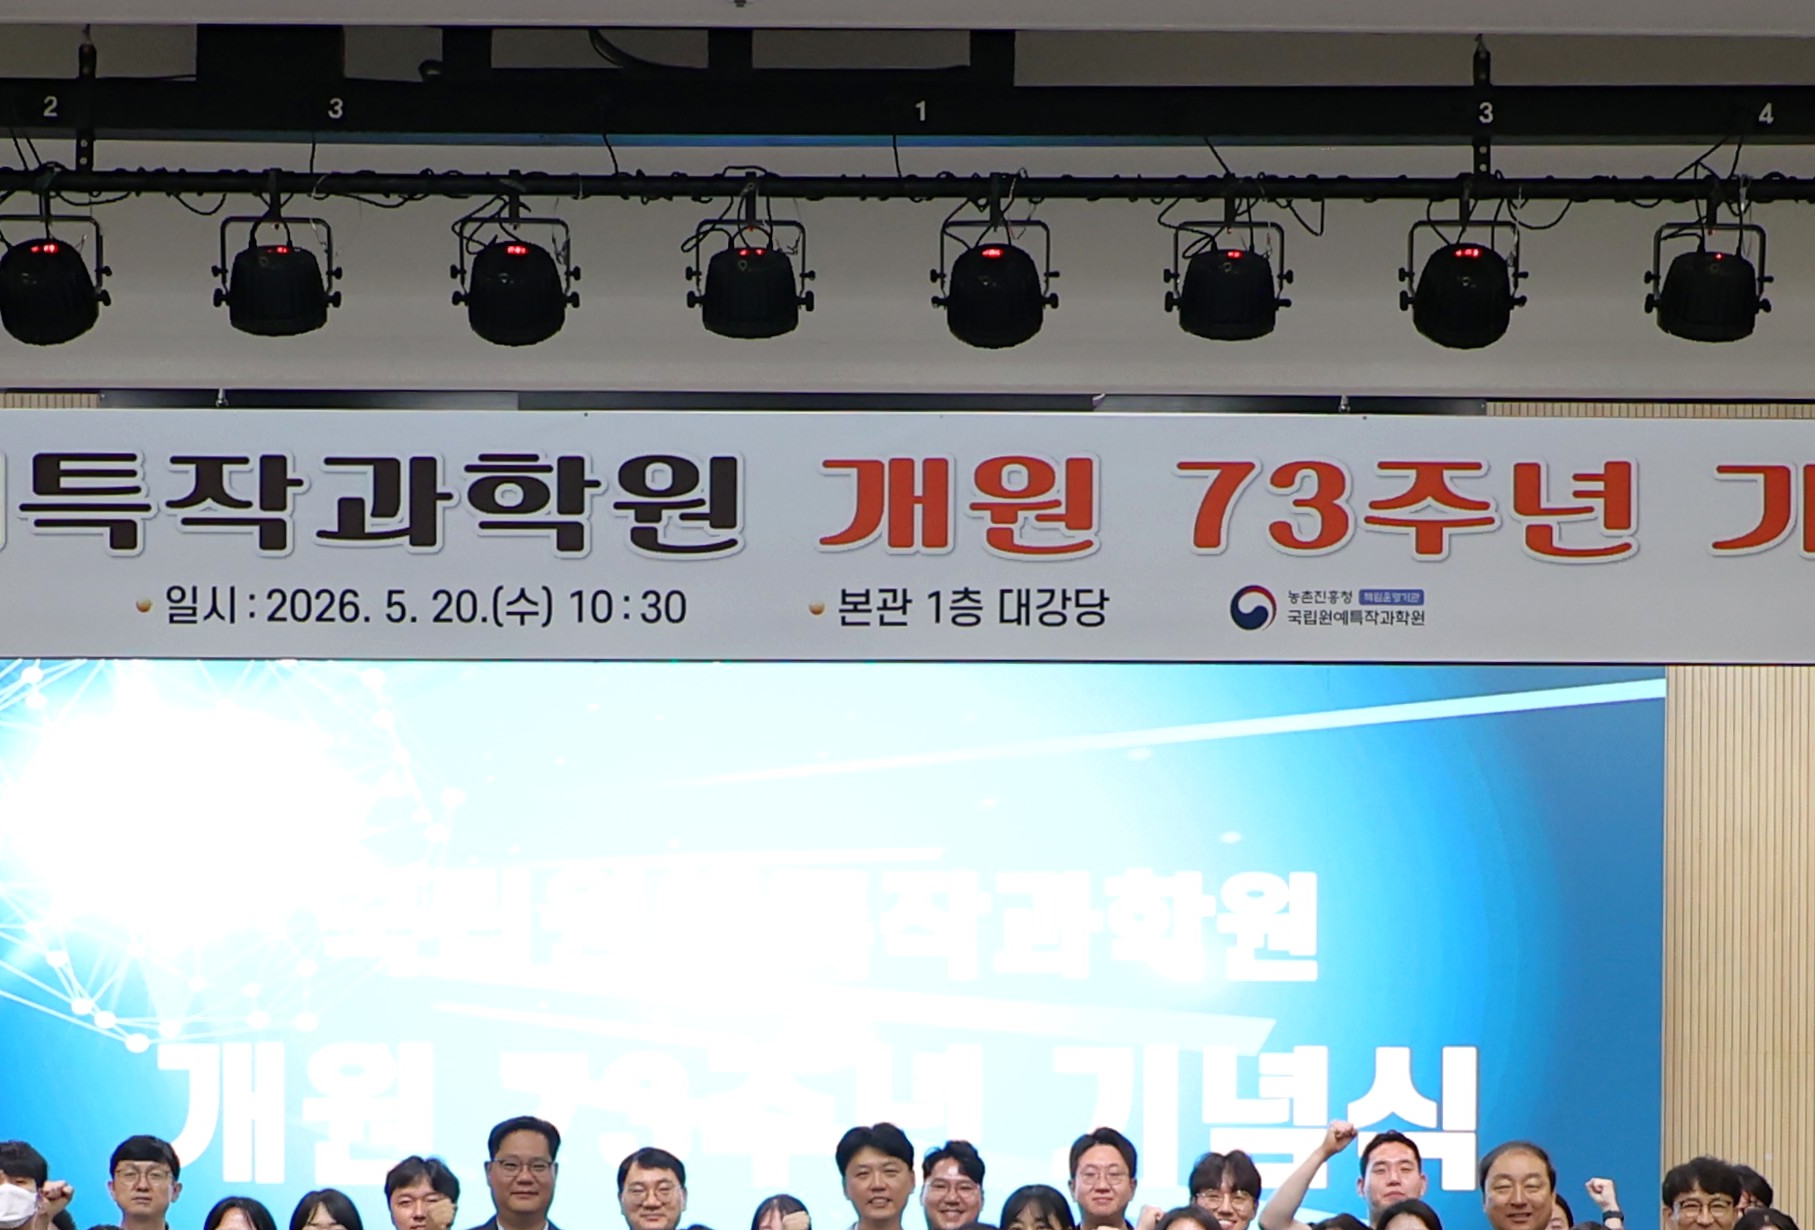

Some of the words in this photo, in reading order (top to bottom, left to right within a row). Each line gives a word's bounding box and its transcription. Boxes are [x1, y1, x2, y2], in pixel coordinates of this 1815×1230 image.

[43, 96, 57, 116] 2
[328, 98, 343, 118] 3
[916, 101, 925, 121] 1
[1479, 102, 1493, 123] 3
[1758, 103, 1774, 123] 4
[822, 456, 1093, 555] 개원
[1179, 461, 1631, 558] 73주년
[385, 589, 417, 624] 5.
[838, 588, 913, 627] 본관
[927, 586, 984, 627] 1층
[999, 588, 1110, 628] 대강당
[1288, 589, 1353, 605] 농촌진흥청
[1288, 609, 1425, 626] 국립원예특작과학원
[156, 1042, 436, 1186] 개원
[1050, 1042, 1477, 1190] 기념식
